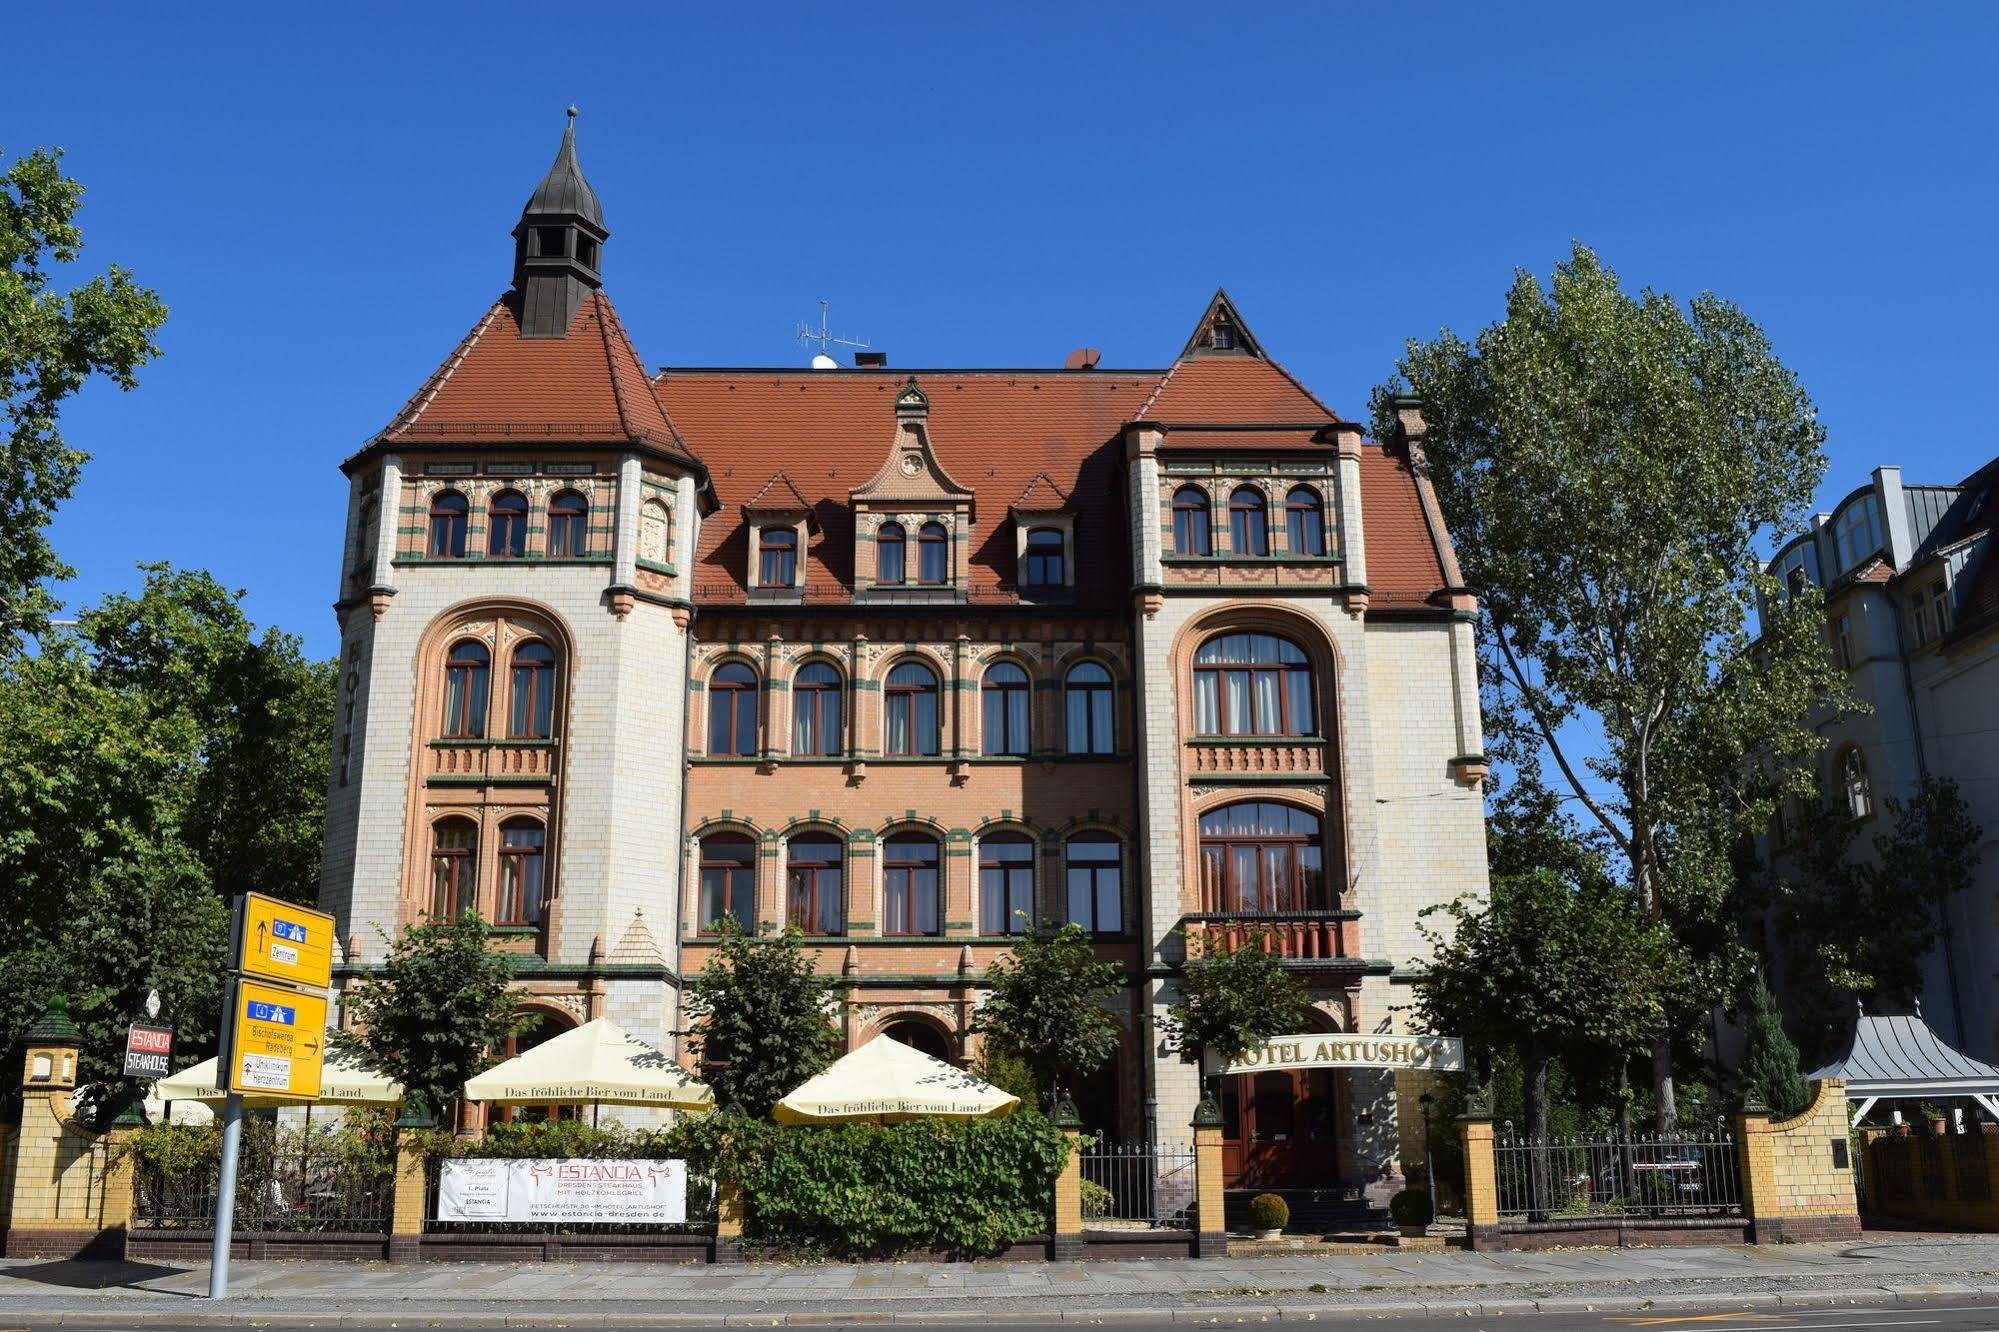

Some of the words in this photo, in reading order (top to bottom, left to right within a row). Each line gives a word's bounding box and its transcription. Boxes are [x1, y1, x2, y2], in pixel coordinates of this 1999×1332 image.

[272, 946, 297, 961] Zentrum
[131, 1030, 170, 1050] ESTANCIA
[252, 1025, 294, 1042] Bischofswerda
[266, 1041, 293, 1056] Radeberg
[1313, 1040, 1444, 1064] ARTUSHOF
[127, 1052, 169, 1073] STEAKHOUSE
[255, 1059, 289, 1072] Uniklinikum
[253, 1074, 288, 1086] Herzzentrum
[196, 1087, 219, 1097] Das
[331, 1086, 364, 1098] Land.
[505, 1087, 527, 1097] Das
[531, 1086, 583, 1097] fröhliche
[586, 1086, 610, 1097] Bier
[613, 1089, 637, 1098] vom
[641, 1088, 675, 1100] Land.
[818, 1104, 840, 1114] Das
[843, 1102, 895, 1113] fröhliche
[897, 1101, 921, 1112] Bier
[925, 1103, 948, 1112] vom
[951, 1102, 984, 1113] Land.
[558, 1165, 642, 1181] ESTANCIA
[531, 1210, 665, 1218] www.estancia-dresden.de
